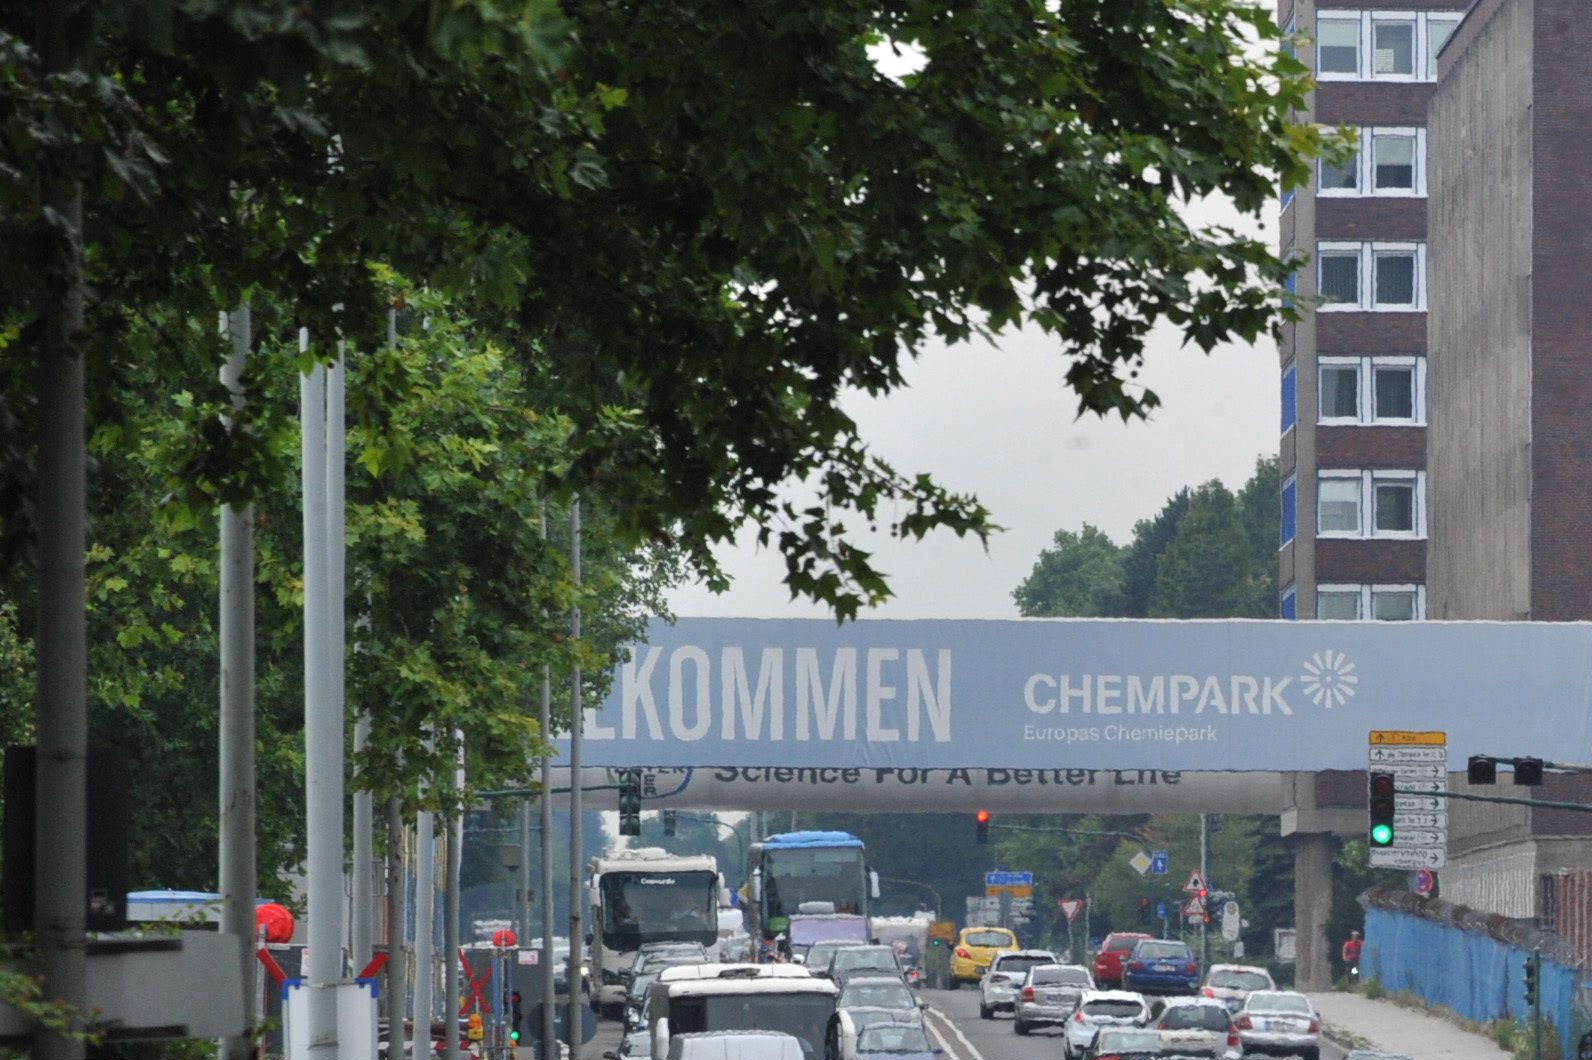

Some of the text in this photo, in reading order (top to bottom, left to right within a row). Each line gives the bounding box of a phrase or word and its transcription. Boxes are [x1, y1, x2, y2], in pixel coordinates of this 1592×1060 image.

[1023, 673, 1294, 716] CHEMPARK
[1024, 724, 1218, 745] Europas Chemiepark
